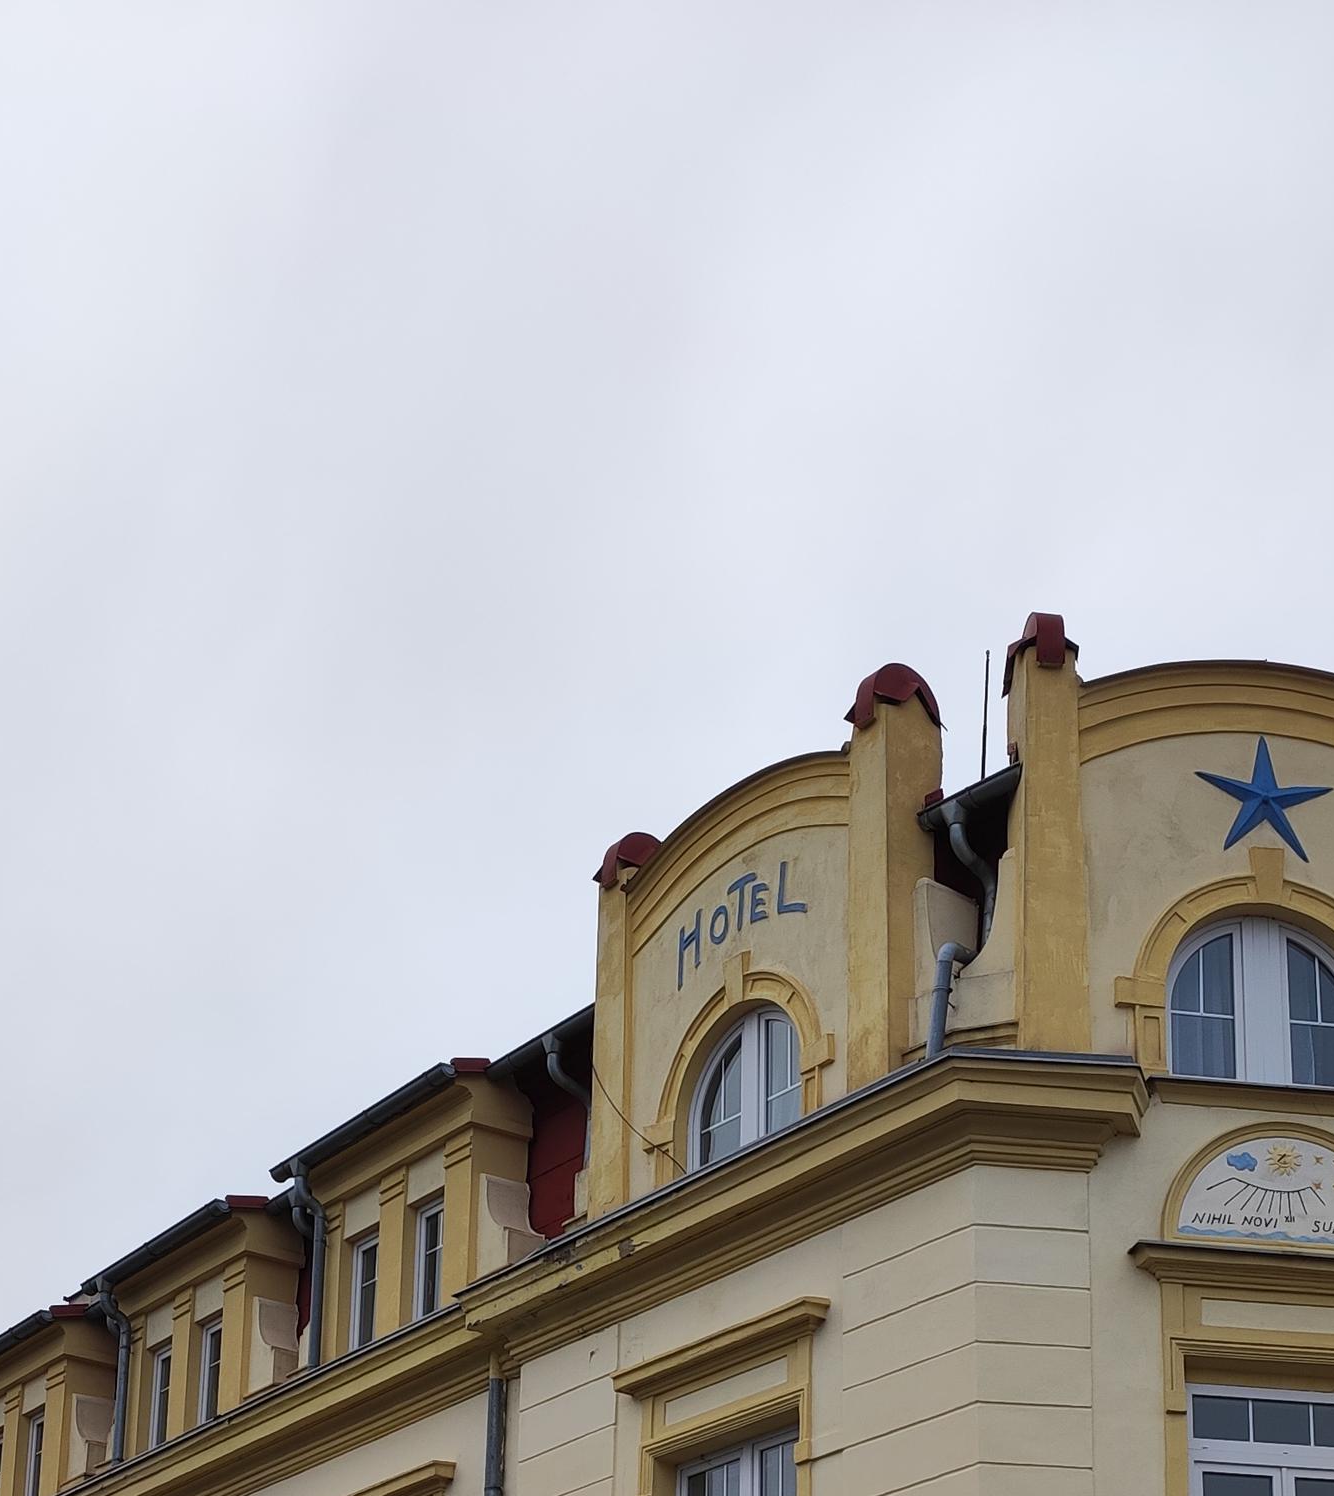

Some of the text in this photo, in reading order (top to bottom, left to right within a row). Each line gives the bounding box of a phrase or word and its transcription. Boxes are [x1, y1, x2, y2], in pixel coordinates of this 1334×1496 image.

[678, 861, 808, 992] HOTEL
[1191, 1212, 1235, 1225] NIHIL
[1241, 1216, 1278, 1229] NOVI
[1284, 1215, 1295, 1223] XII
